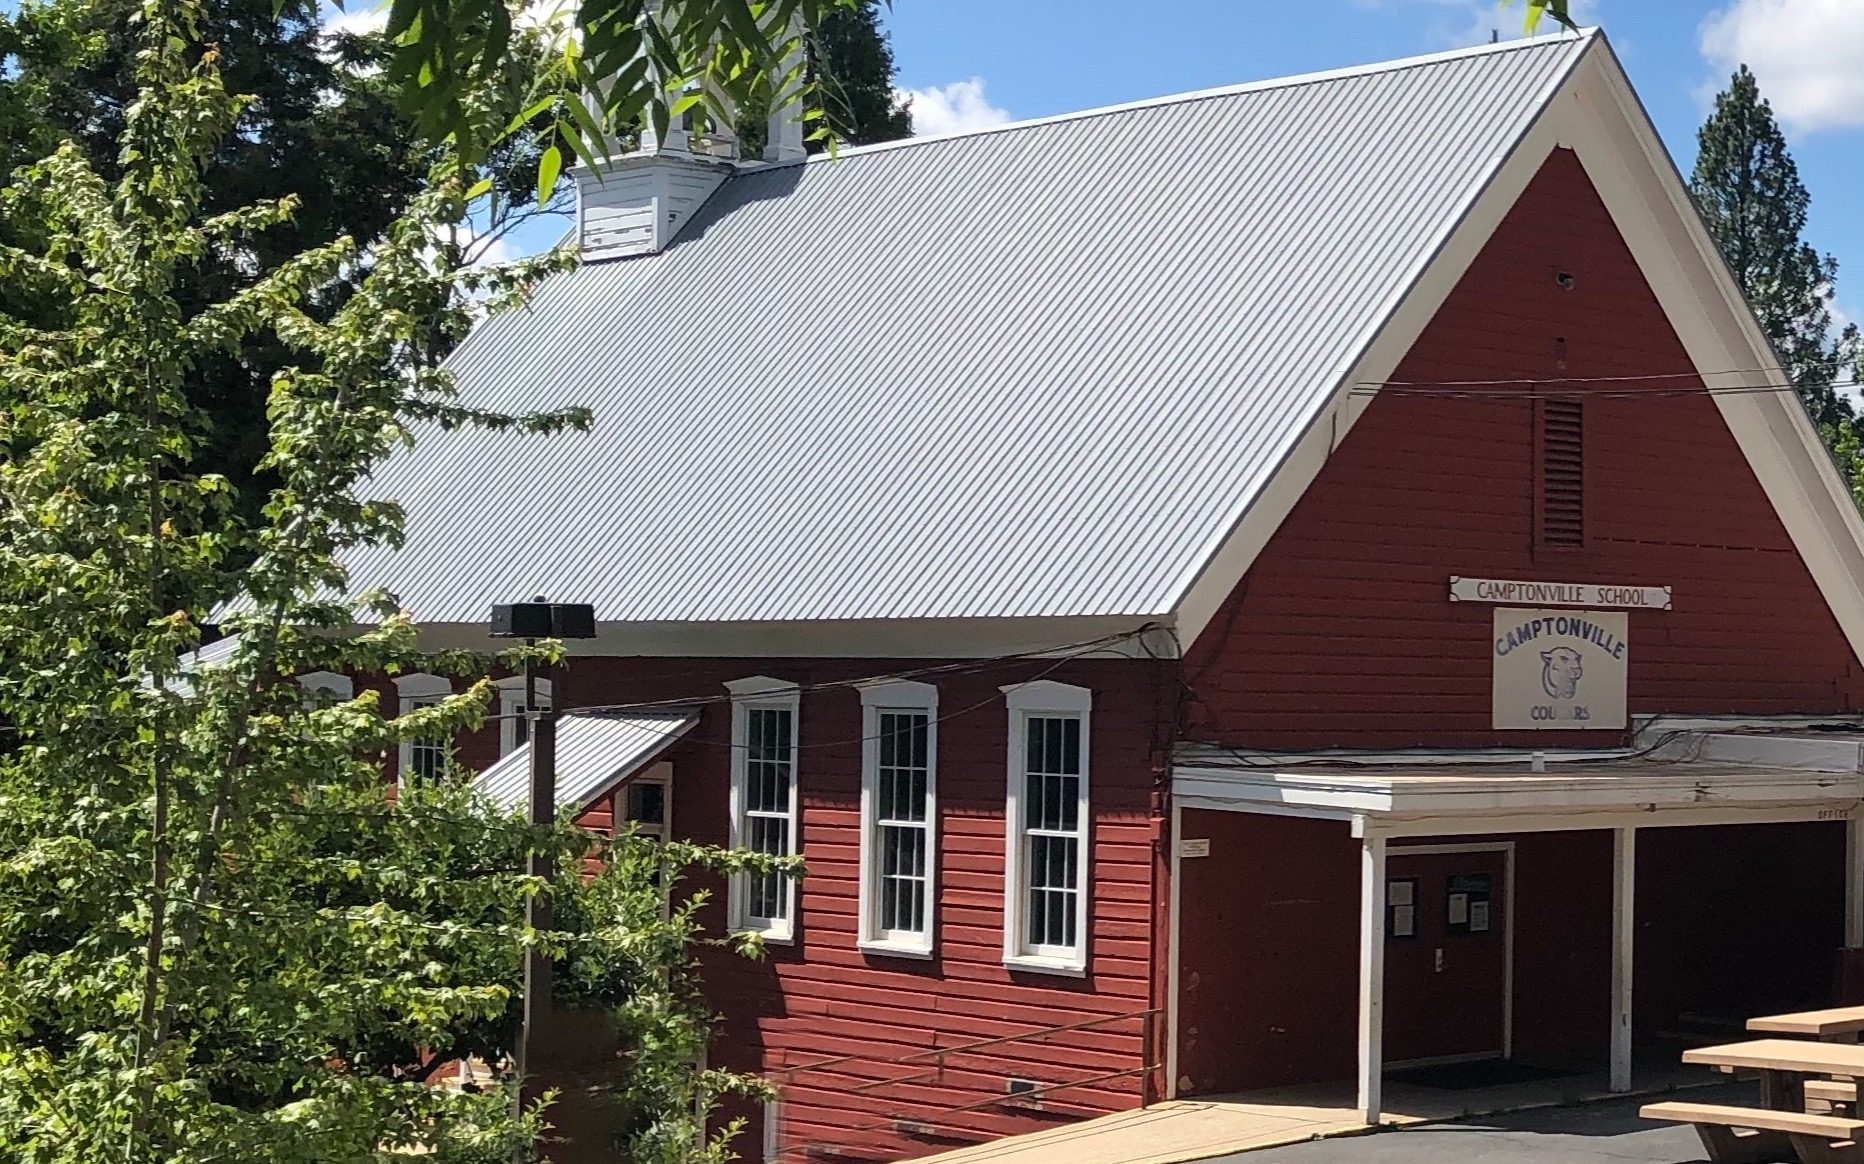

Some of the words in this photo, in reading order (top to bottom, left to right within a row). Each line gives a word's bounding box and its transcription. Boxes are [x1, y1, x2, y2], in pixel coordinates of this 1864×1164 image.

[1477, 582, 1584, 602] CAMPTONVILLE
[1597, 587, 1648, 605] SCHOOL
[1495, 616, 1625, 660] CAMPTONVILLE
[1531, 705, 1590, 720] COURS
[1818, 810, 1849, 820] OFFICE
